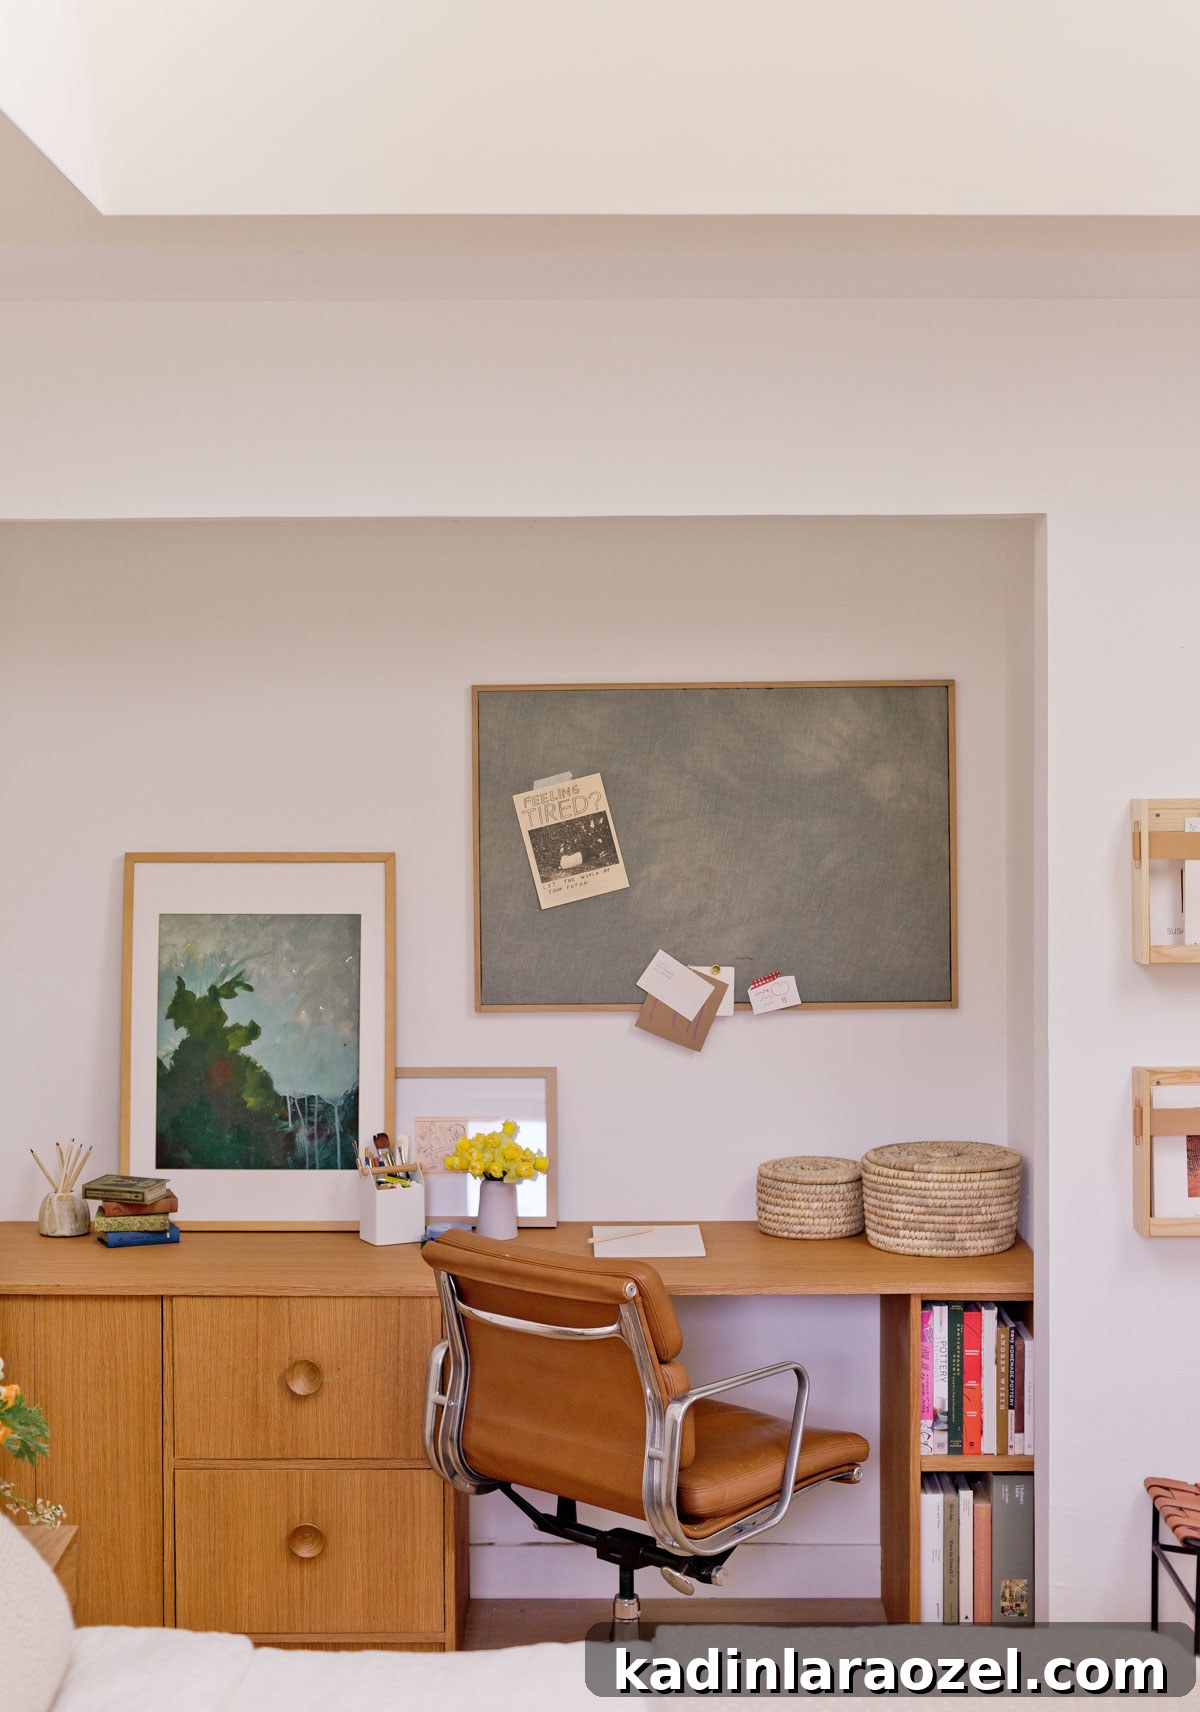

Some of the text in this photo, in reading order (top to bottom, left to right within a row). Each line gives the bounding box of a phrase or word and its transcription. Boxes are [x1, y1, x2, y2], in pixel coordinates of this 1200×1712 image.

[521, 791, 602, 826] TIRED?
[523, 784, 580, 808] FEELING
[939, 1341, 947, 1383] POTTERY
